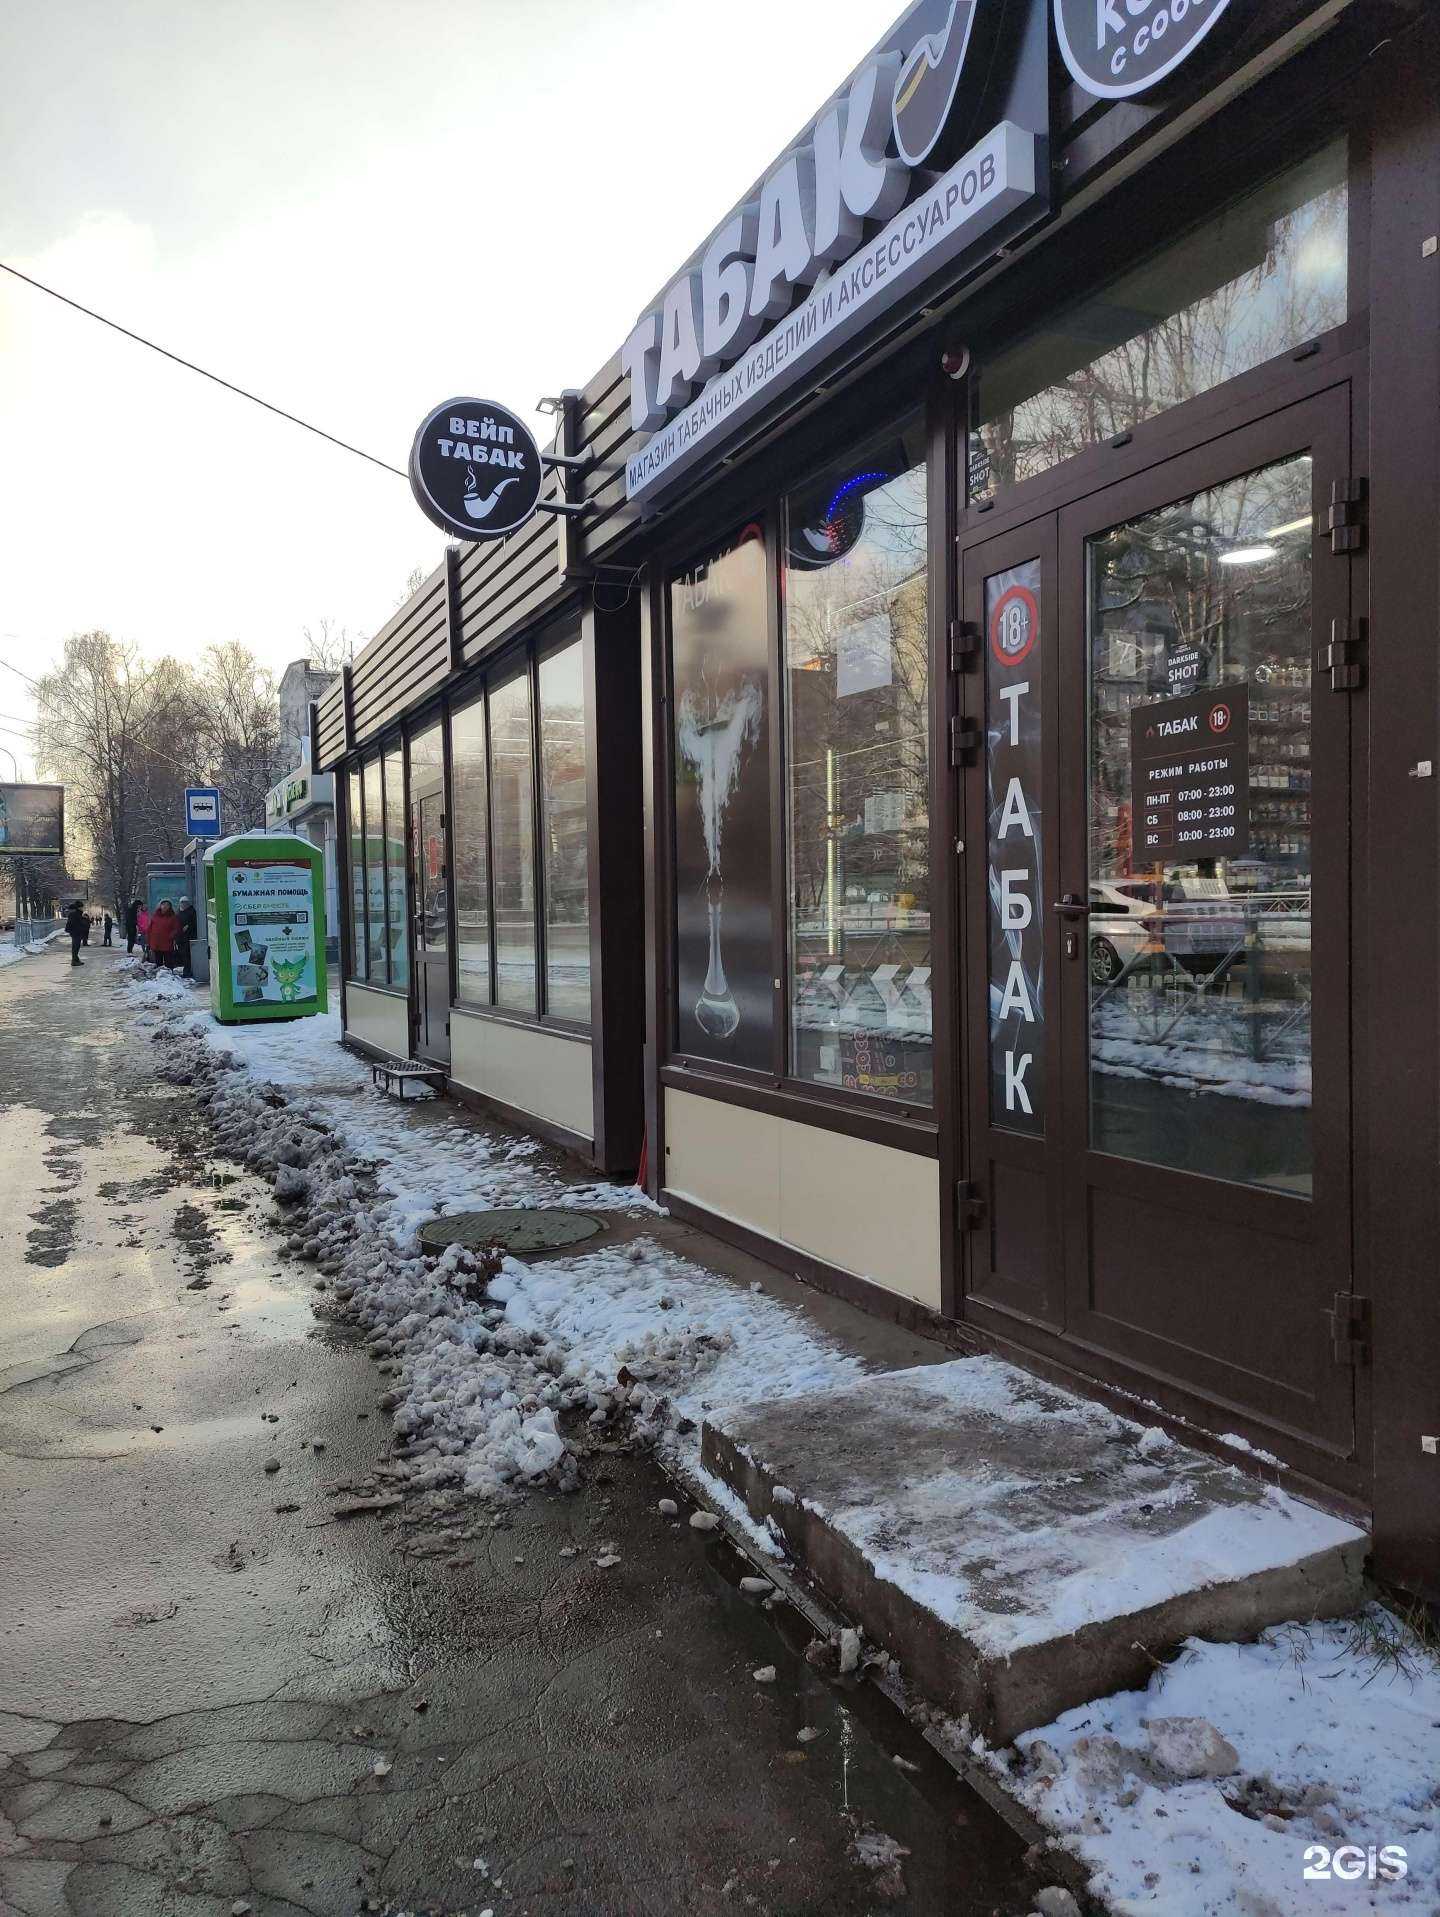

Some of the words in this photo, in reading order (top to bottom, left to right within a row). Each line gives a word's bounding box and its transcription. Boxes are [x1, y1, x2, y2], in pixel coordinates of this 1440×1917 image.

[621, 63, 888, 431] ТАБАК
[629, 433, 676, 489] МАГАЗИН
[677, 369, 744, 445] ТАБАЧНЫХ
[747, 302, 818, 388] ИЗДЕЛИЙ
[823, 294, 833, 324] И
[838, 153, 996, 312] АКСЕССУАРОВ
[449, 417, 514, 444] ВЕЙП
[437, 439, 526, 470] ТАБАК
[970, 466, 990, 486] SHOT
[999, 605, 1029, 649] 18+
[1168, 651, 1199, 666] DARKSIDE
[1168, 663, 1199, 682] SHOT
[1157, 715, 1198, 737] ТАБАК
[1149, 765, 1183, 780] РЕЖИМ
[1188, 758, 1228, 774] РАБОТЫ
[1146, 793, 1171, 806] ПН-ПТ
[1178, 789, 1202, 802] 07:00
[1208, 784, 1235, 798] 23:00
[1147, 814, 1159, 825] СБ
[1178, 809, 1203, 822] 08:00
[1208, 805, 1235, 818] 23:00
[1147, 834, 1159, 845] ВС
[1178, 829, 1203, 842] 10:00
[1208, 826, 1235, 839] 23:00
[232, 889, 276, 897] БУМАЖНАЯ
[277, 888, 309, 896] ПОМОЩЬ
[997, 681, 1035, 1114] ТАБАК
